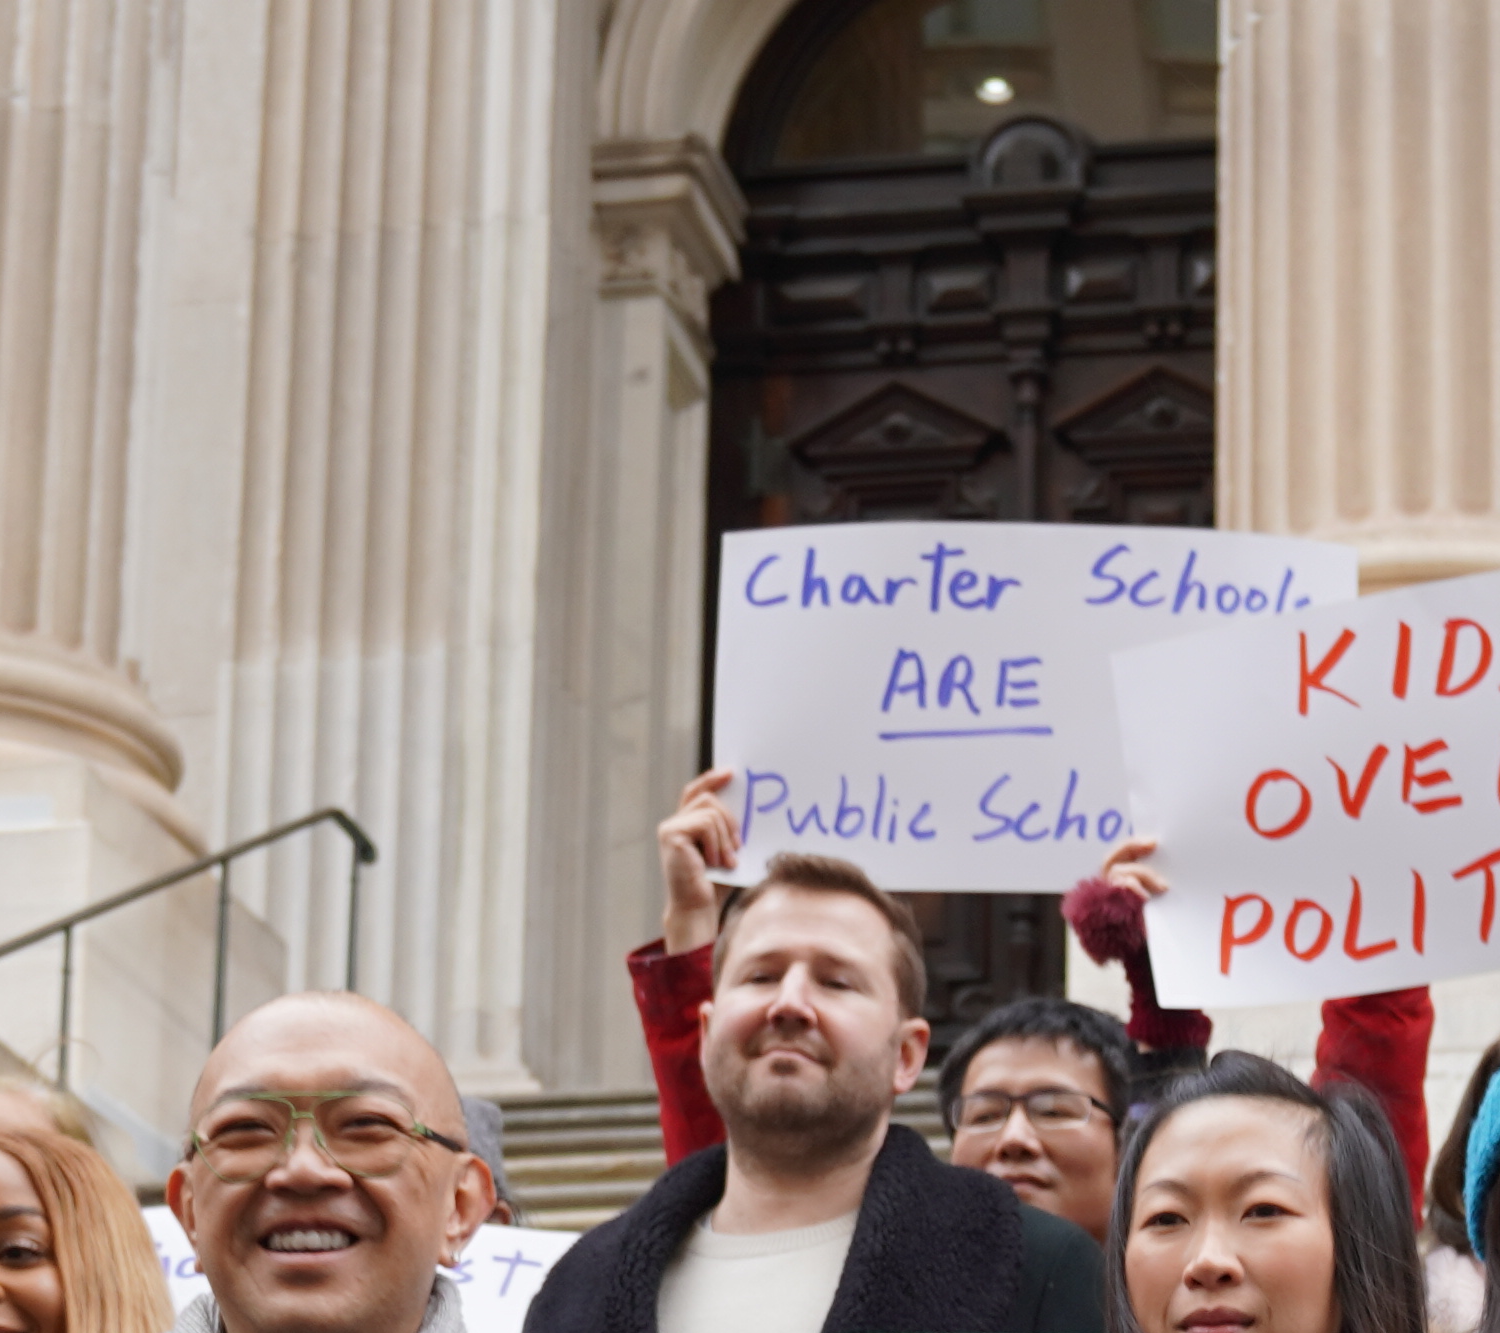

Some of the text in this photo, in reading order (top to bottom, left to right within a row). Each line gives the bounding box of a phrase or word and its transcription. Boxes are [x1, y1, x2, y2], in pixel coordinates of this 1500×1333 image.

[744, 541, 1312, 614] Charter School
[880, 647, 1045, 716] ARE
[740, 769, 1134, 845] Public Scho
